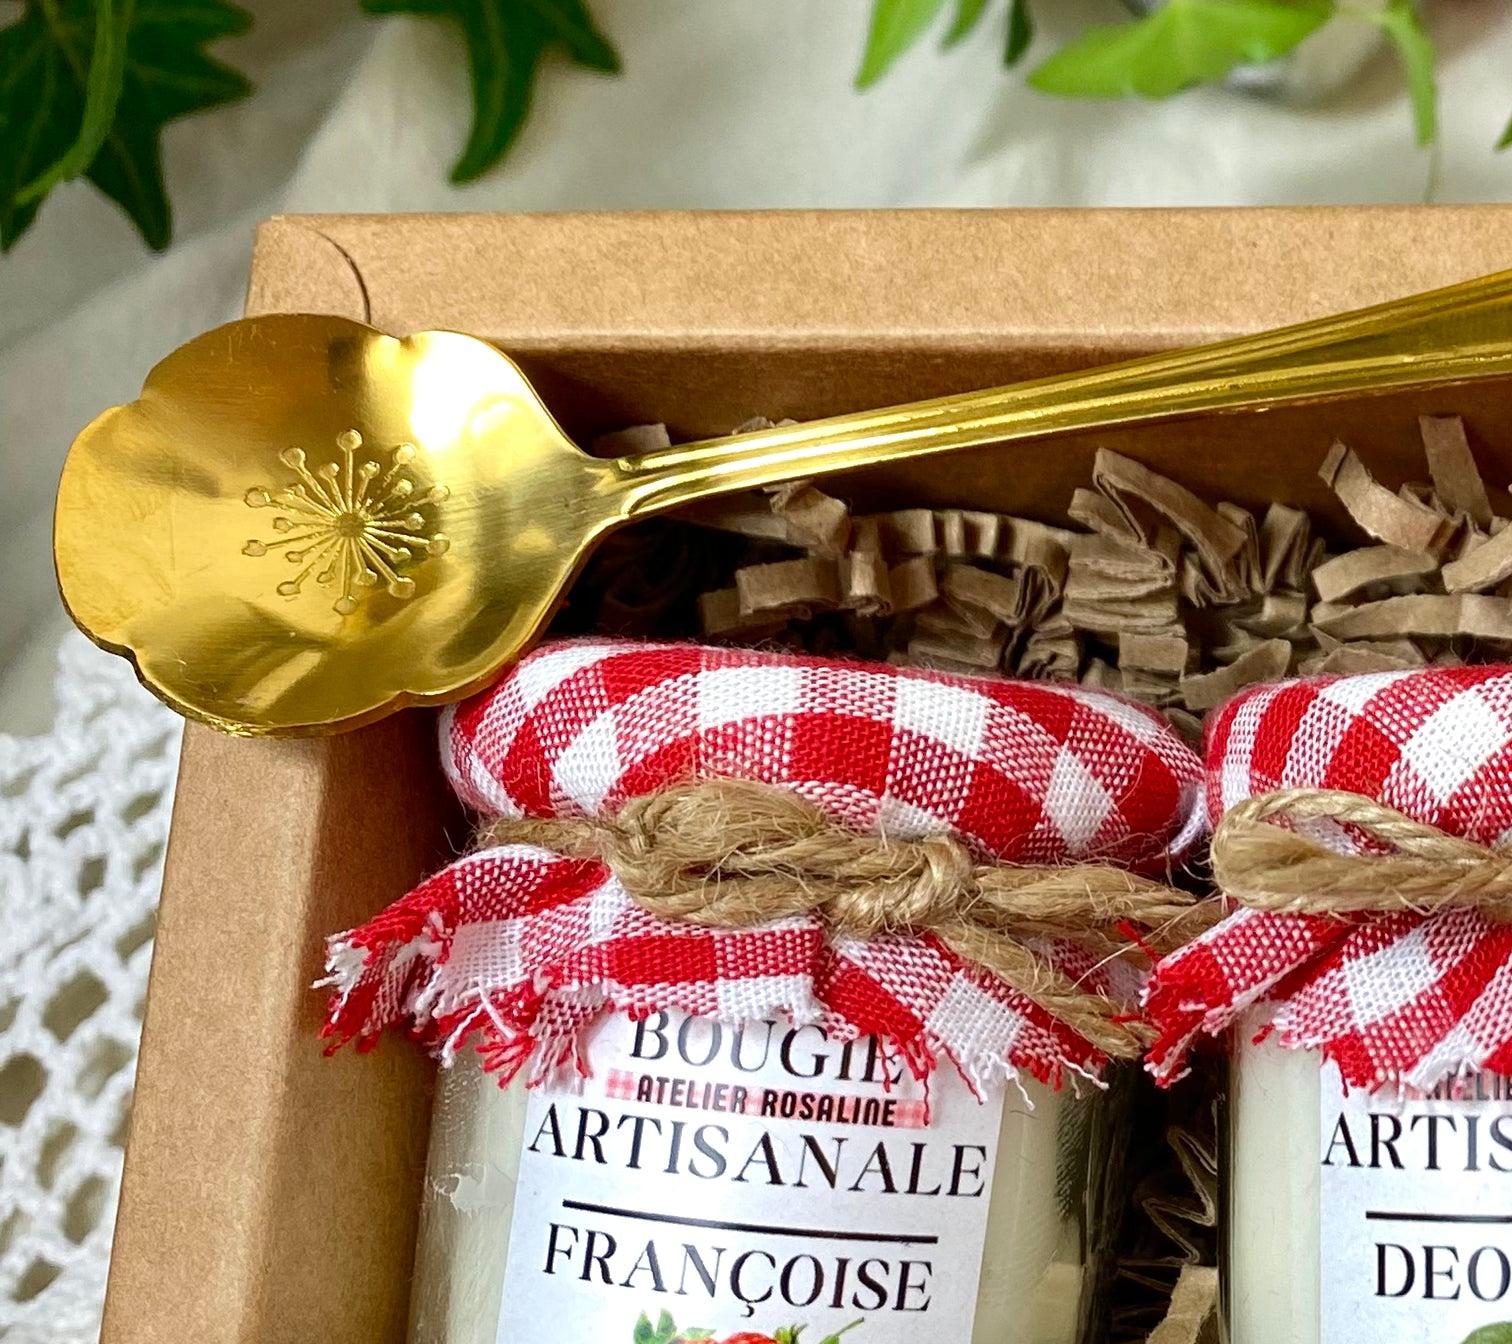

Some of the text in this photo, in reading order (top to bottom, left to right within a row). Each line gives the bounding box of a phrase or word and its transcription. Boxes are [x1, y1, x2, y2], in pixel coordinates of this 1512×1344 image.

[636, 1073, 898, 1128] ATELIER ROSALINE
[527, 1101, 988, 1199] ARTISANALE
[542, 1220, 934, 1319] FRANÇOISE
